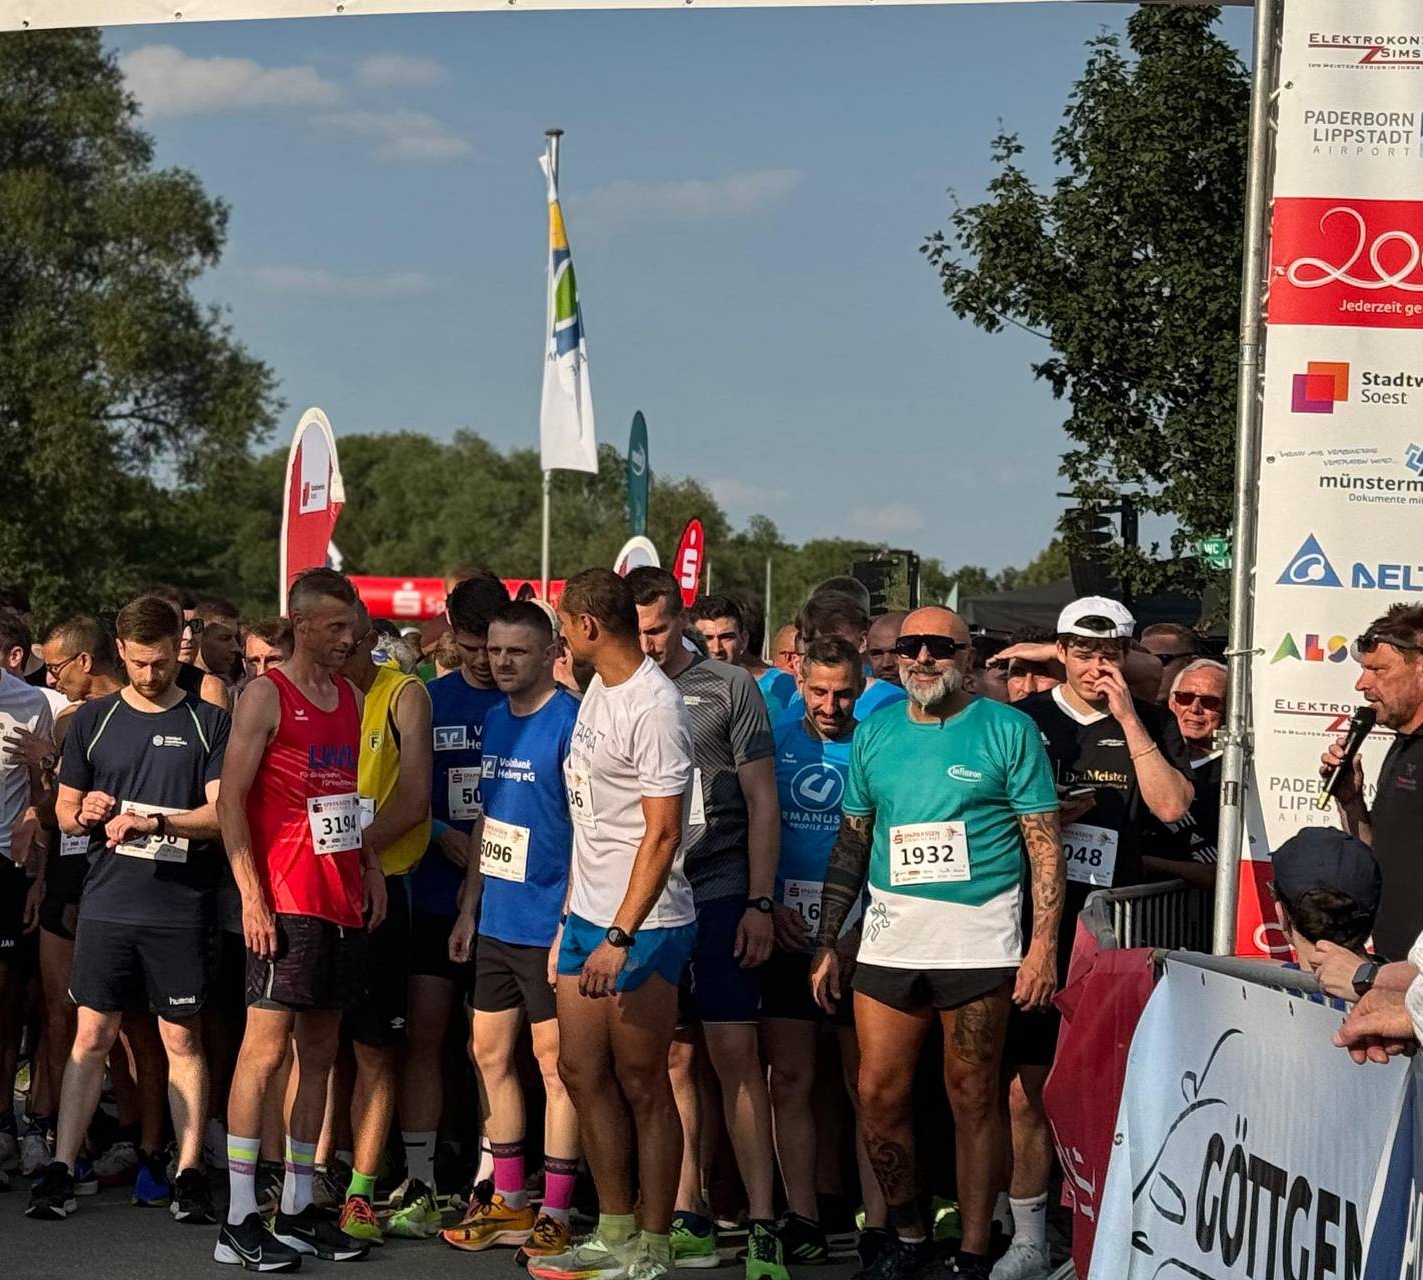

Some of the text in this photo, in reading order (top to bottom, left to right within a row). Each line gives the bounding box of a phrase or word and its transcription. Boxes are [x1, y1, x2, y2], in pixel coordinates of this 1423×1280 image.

[1309, 33, 1423, 45] ELEKTROKON
[1305, 110, 1414, 127] PADERBORN
[1313, 128, 1413, 144] LIPPSTADT
[1313, 146, 1411, 157] AIRPORT
[1339, 299, 1403, 314] Jederzeit
[1361, 389, 1407, 405] Soest
[1349, 493, 1406, 505] Dokumente
[1204, 543, 1219, 554] WC
[322, 815, 356, 835] 3194
[901, 845, 955, 866] 1932
